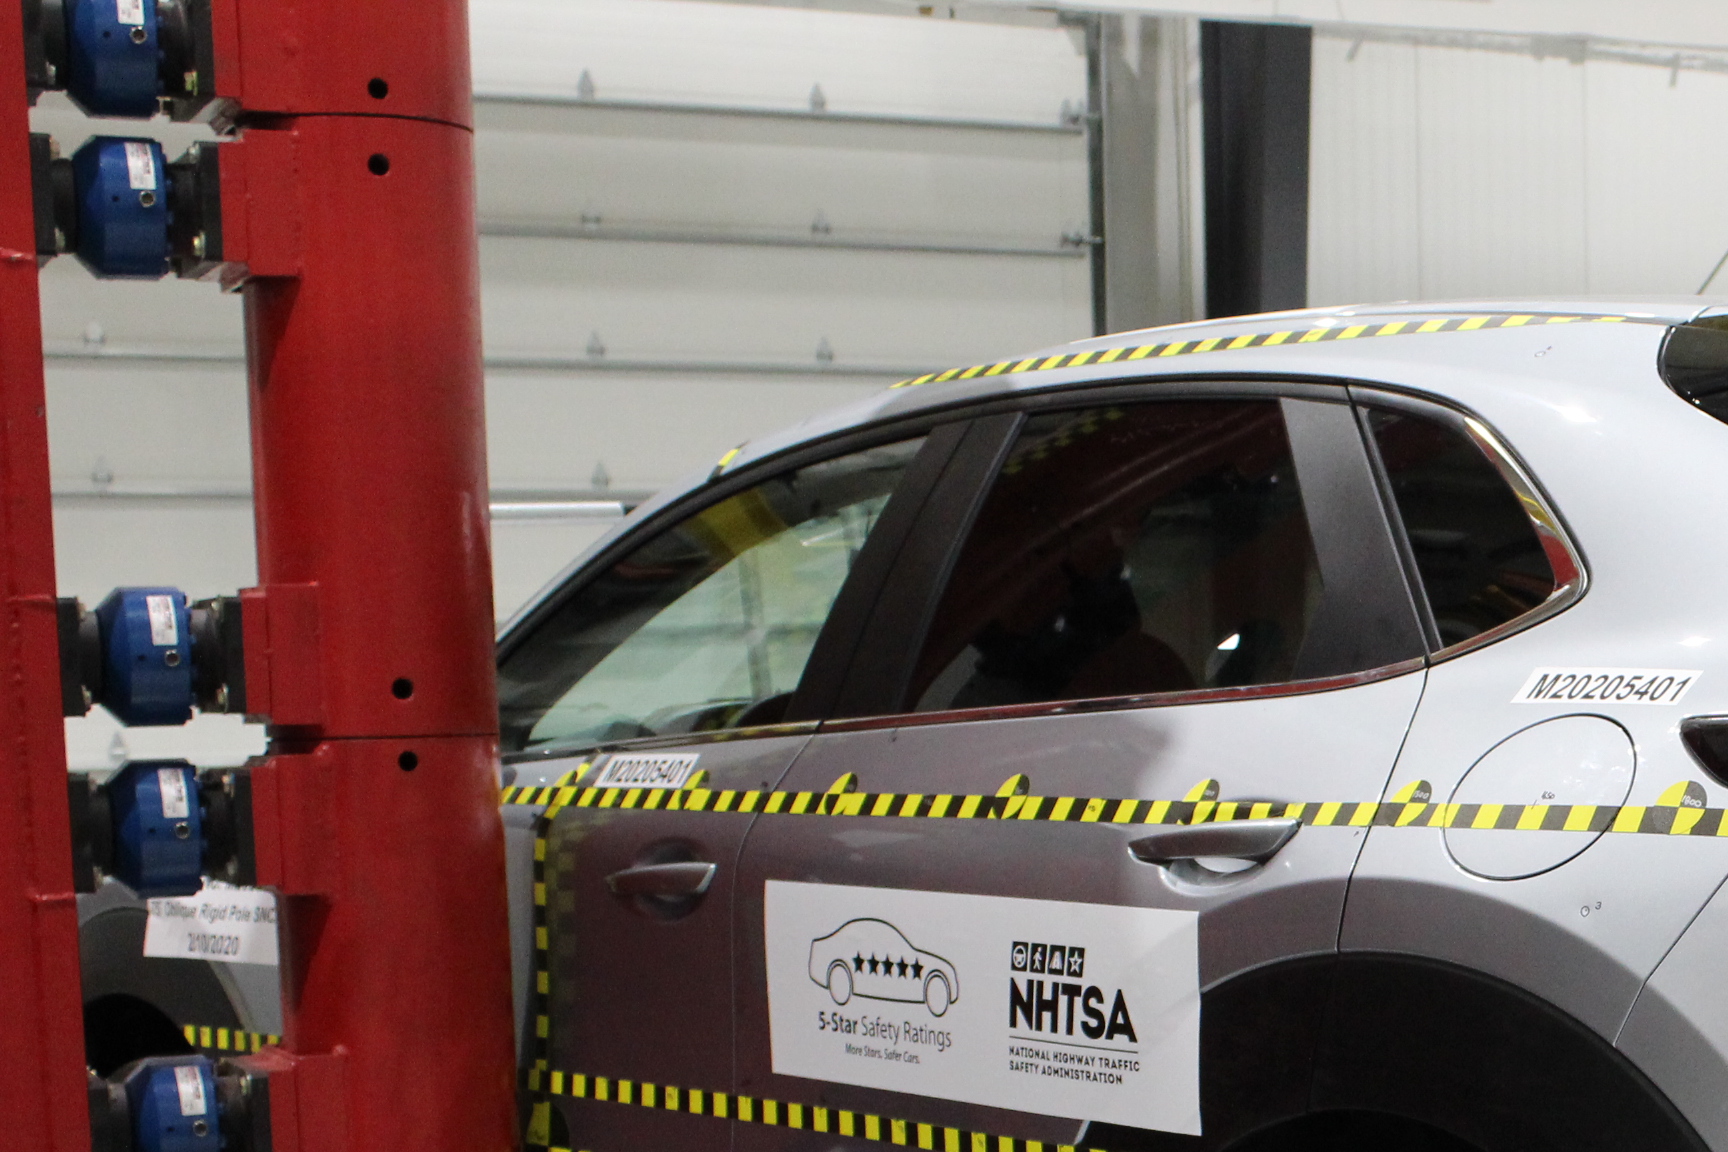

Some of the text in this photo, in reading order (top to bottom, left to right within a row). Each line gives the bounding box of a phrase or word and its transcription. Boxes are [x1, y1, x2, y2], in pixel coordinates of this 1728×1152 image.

[1526, 673, 1693, 702] M20205401
[603, 759, 692, 783] M20205401
[200, 903, 227, 923] Rigid
[229, 905, 251, 922] Pole
[253, 906, 276, 923] SNC
[1009, 977, 1138, 1043] NHTSA
[818, 1011, 952, 1052] 5-Star Safety Ratings
[845, 1043, 862, 1056] More
[884, 1048, 902, 1061] Safer
[1009, 1046, 1140, 1072] NATIONAL HIGHWAY TRAFFIC
[1009, 1060, 1123, 1085] SAFETY ADMINISTRATION
